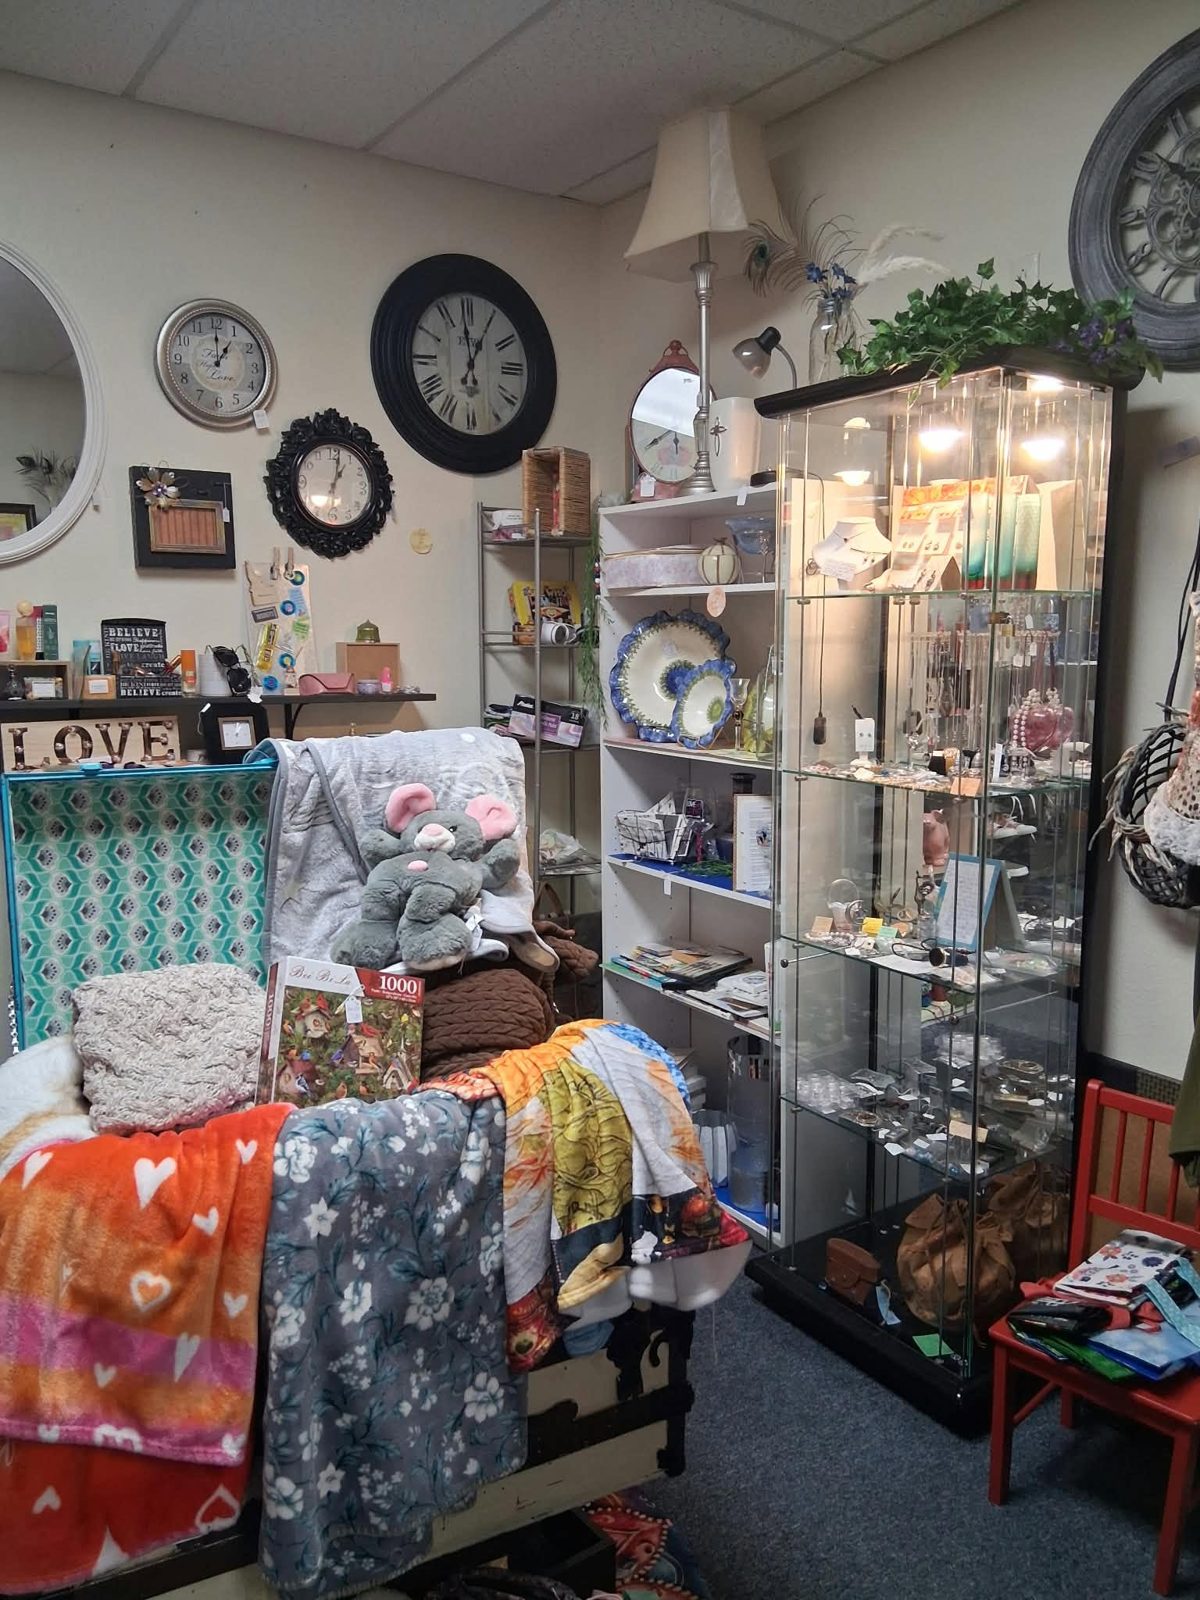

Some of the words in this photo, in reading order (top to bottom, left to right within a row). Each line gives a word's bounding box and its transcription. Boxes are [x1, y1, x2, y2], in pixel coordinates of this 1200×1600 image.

[192, 321, 202, 333] 11
[210, 318, 222, 330] 12
[232, 326, 237, 337] 1
[177, 335, 190, 346] 10
[246, 342, 254, 354] 2
[174, 353, 182, 365] 9
[251, 363, 259, 374] 3
[180, 372, 188, 384] 8
[247, 382, 254, 391] 4
[196, 390, 204, 401] 7
[232, 394, 240, 405] 5
[215, 396, 223, 408] 6
[108, 627, 159, 637] BELIEVE
[115, 642, 139, 652] LOVE
[120, 688, 161, 696] BELIEVE
[8, 720, 175, 771] LOVE
[380, 975, 418, 995] 1000
[264, 994, 275, 1026] 1000
